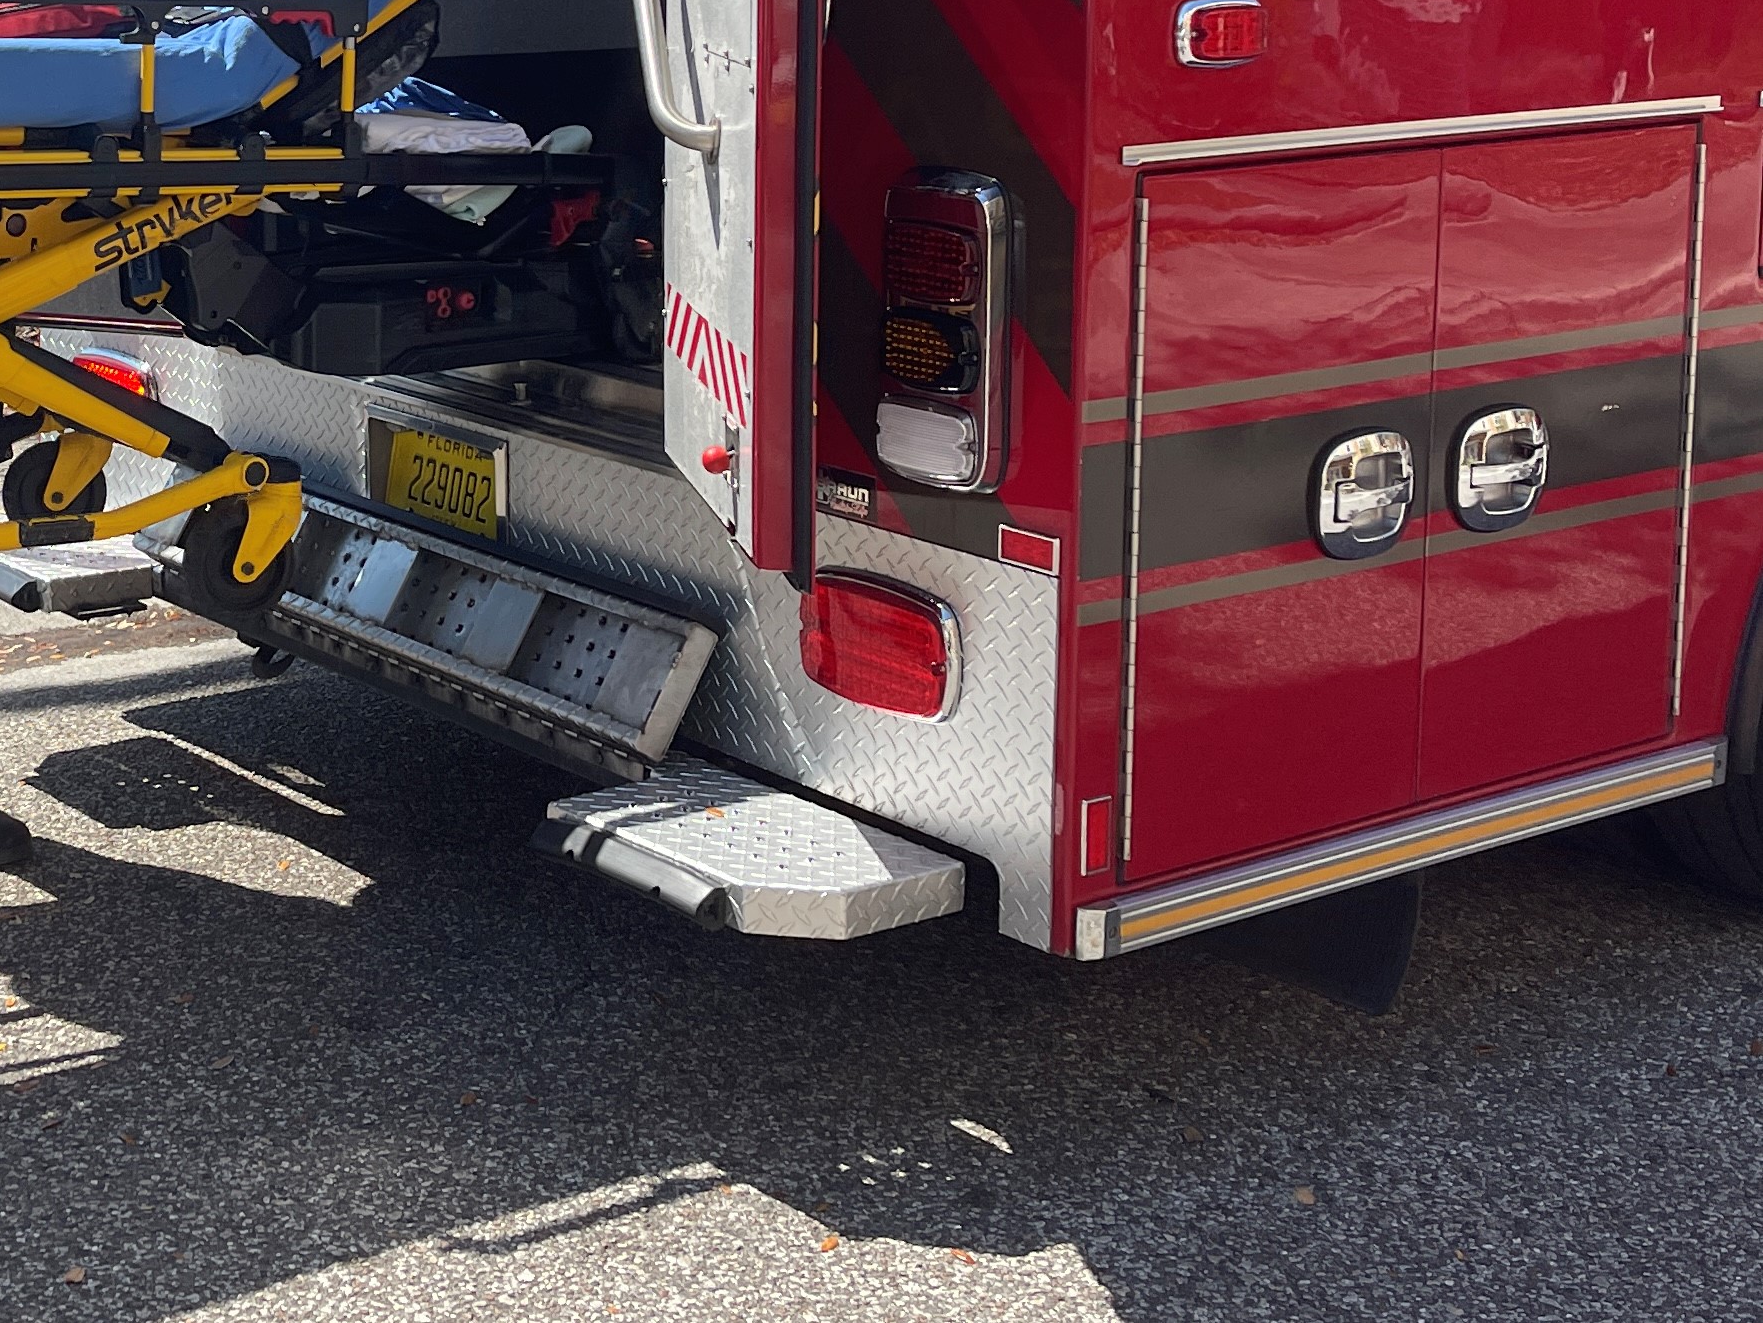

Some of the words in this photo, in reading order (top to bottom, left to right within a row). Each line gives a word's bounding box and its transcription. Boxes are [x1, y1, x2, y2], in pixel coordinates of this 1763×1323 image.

[93, 193, 233, 273] stryker
[426, 433, 484, 463] FLORIDA
[407, 454, 492, 524] 229082
